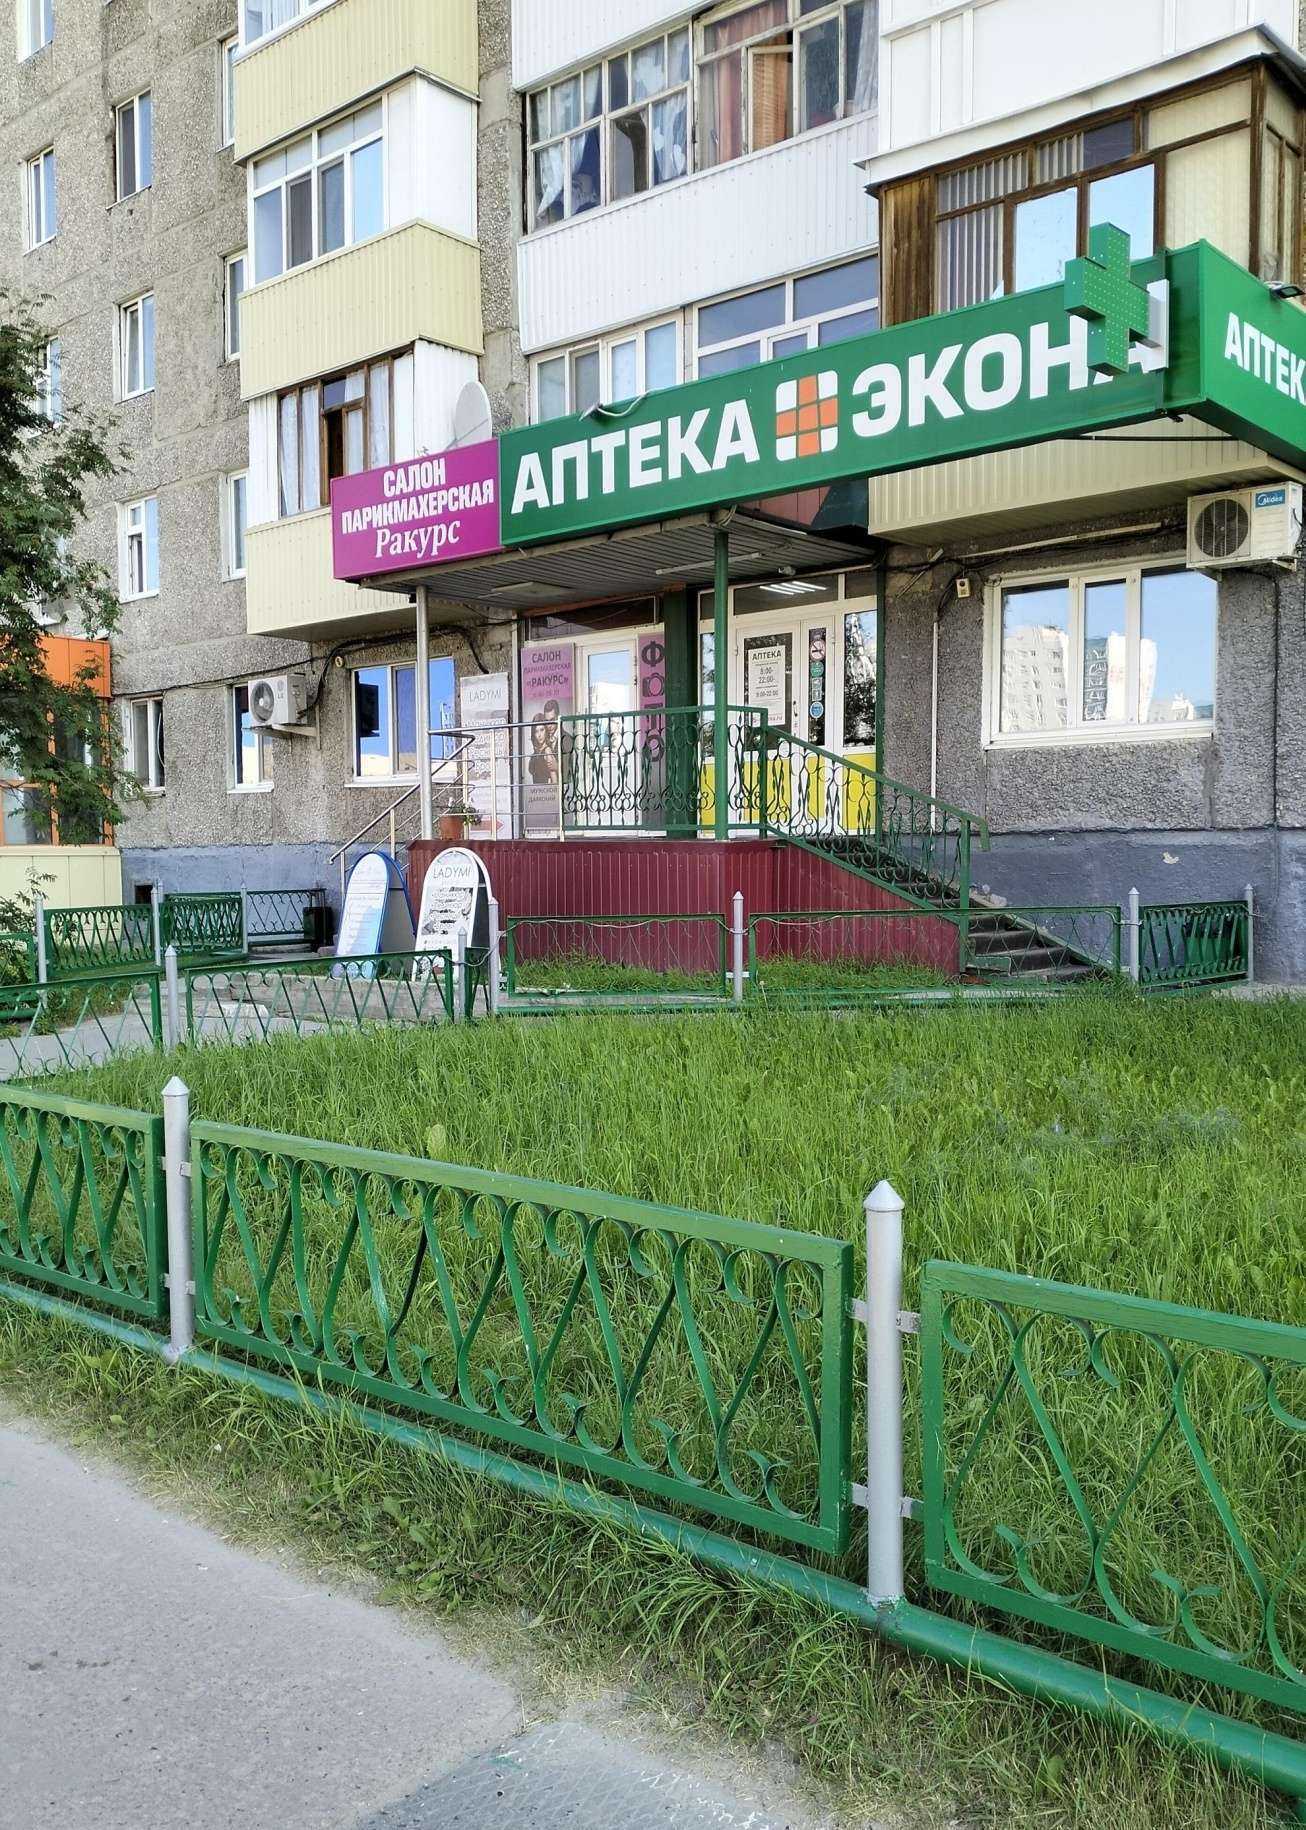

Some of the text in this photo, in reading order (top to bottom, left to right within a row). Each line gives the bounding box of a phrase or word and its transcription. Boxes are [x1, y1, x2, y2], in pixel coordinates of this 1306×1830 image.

[510, 398, 760, 515] АПТЕКА
[383, 457, 446, 497] САЛОН
[341, 478, 494, 535] ПАРИКМАХЕРСКАЯ
[1257, 493, 1283, 506] Midea
[375, 520, 461, 559] Ракурс
[531, 650, 562, 663] САЛОН
[752, 650, 782, 661] АПТЕКА
[433, 866, 471, 879] LADYMI
